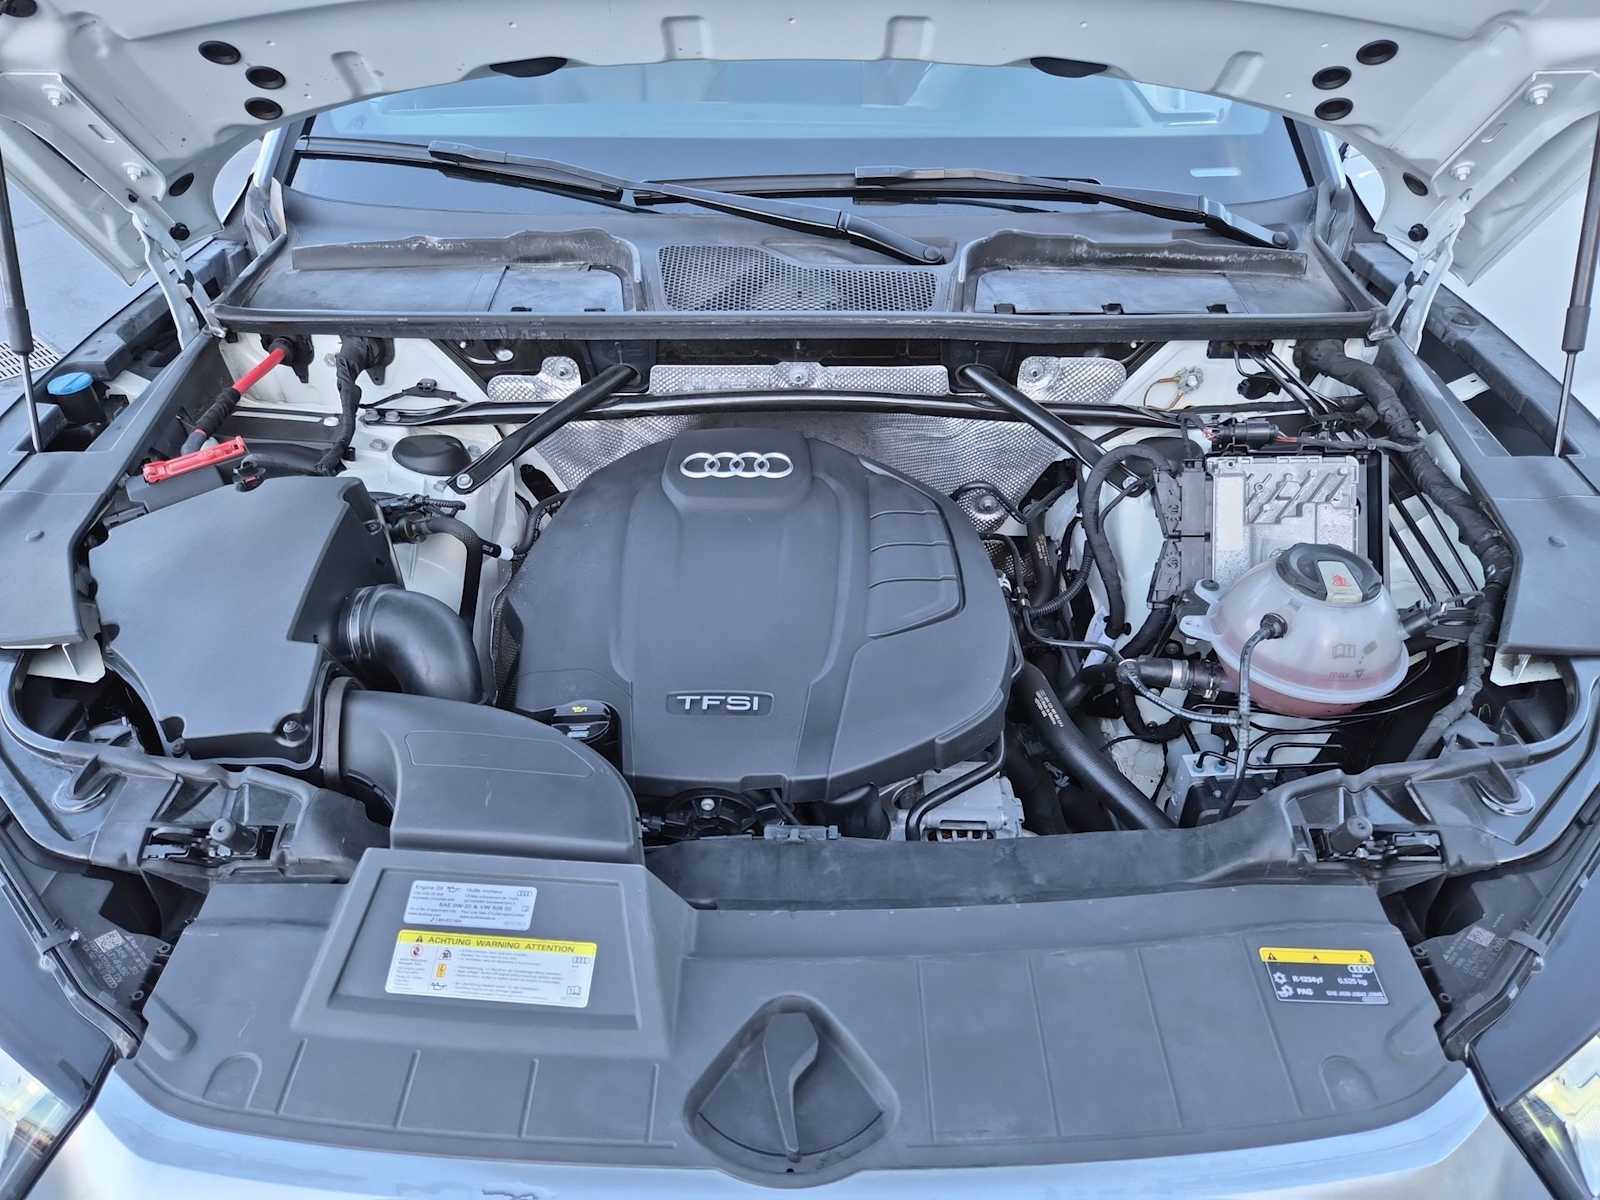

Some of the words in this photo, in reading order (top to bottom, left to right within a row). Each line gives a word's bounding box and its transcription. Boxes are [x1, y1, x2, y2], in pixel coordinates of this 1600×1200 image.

[676, 695, 759, 711] TFSI
[428, 936, 471, 946] ACHTUNG
[476, 939, 520, 949] WARNING
[525, 942, 575, 953] ATTENTION
